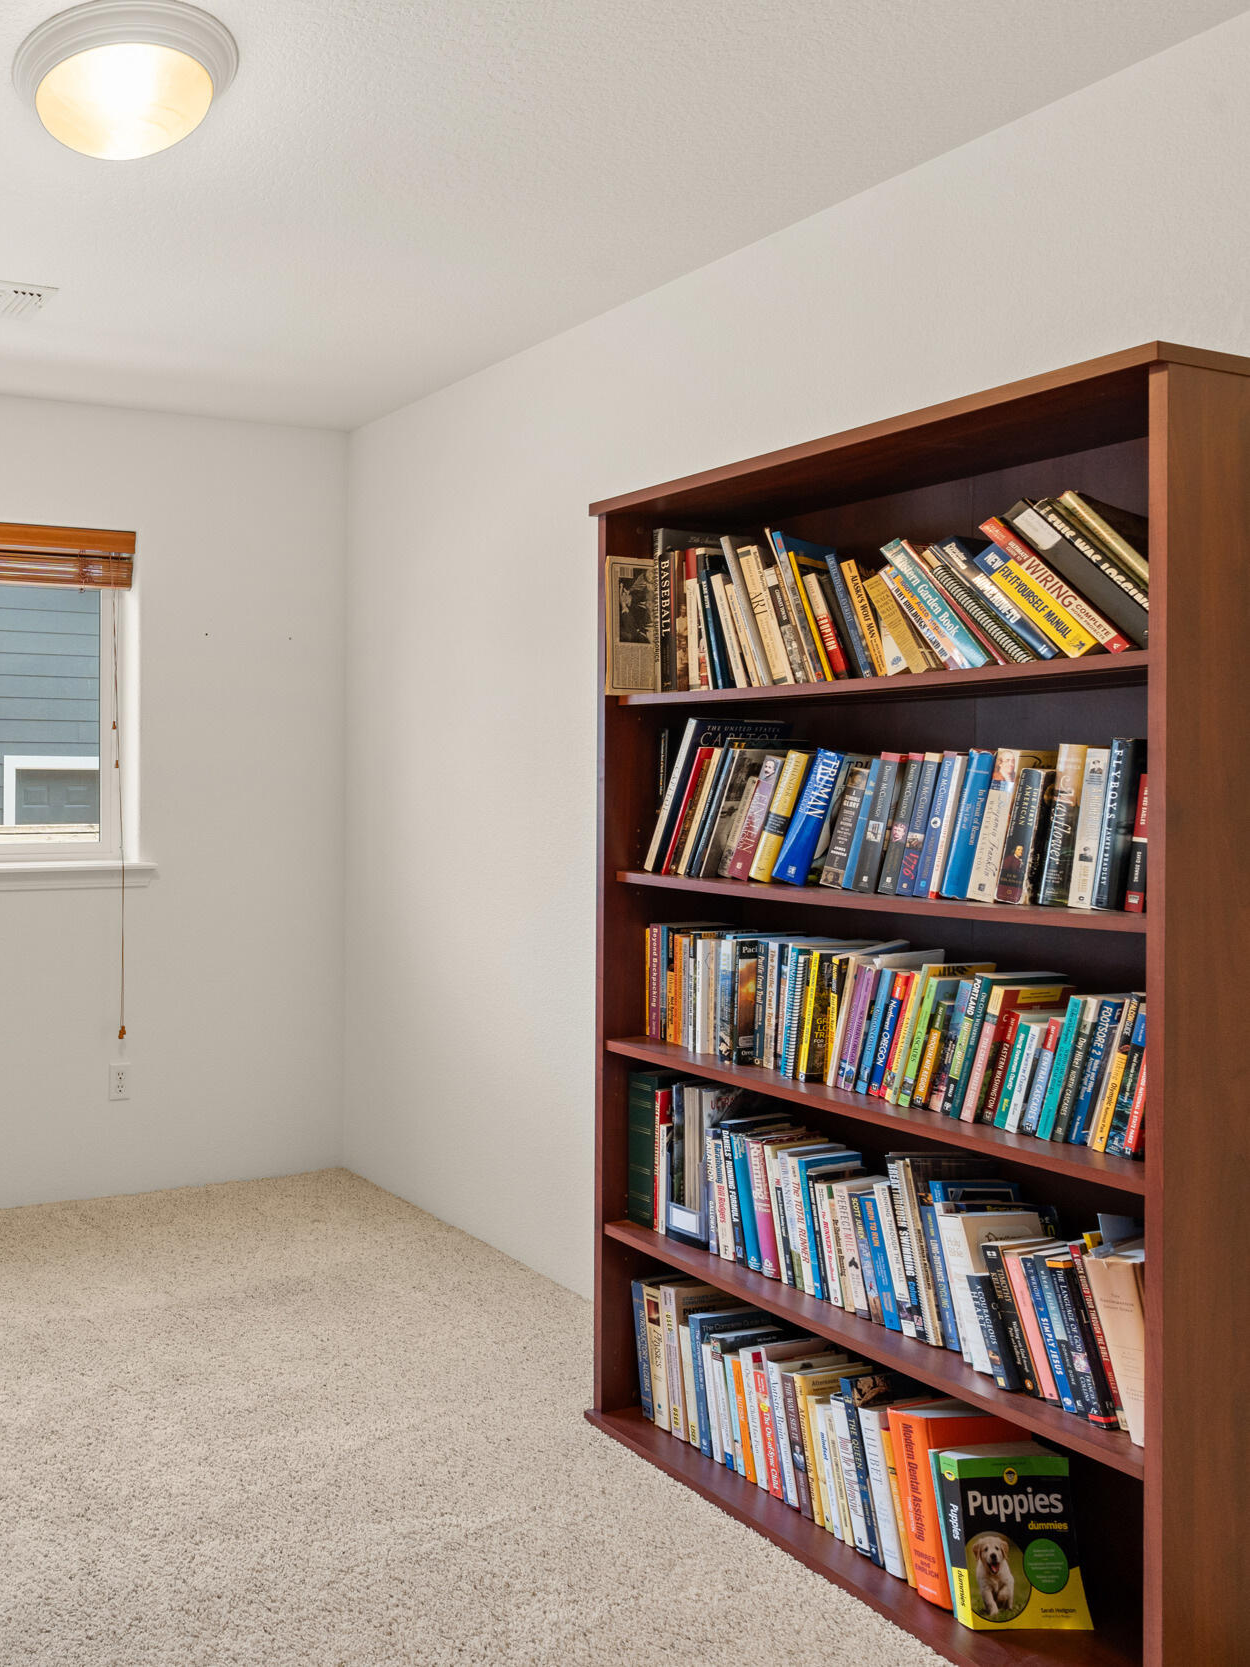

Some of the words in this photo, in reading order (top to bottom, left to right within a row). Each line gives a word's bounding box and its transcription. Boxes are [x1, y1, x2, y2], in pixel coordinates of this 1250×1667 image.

[984, 551, 1004, 570] NEW
[1009, 542, 1028, 559] ULTIMATE
[661, 561, 670, 635] BASEBALL
[1026, 560, 1076, 607] WIRING
[750, 591, 768, 616] ART
[851, 576, 864, 602] ALASKA'S
[859, 603, 871, 622] WOLF
[865, 622, 876, 638] MAN
[916, 583, 943, 615] Garden
[939, 612, 958, 636] Book
[1000, 566, 1047, 611] FIX-IT-YOURSELF
[1043, 608, 1073, 638] MANUAL
[818, 613, 836, 650] ERUPTION
[892, 587, 906, 601] WHY
[904, 600, 926, 628] BUILDINGS
[937, 647, 948, 657] UP
[1076, 604, 1109, 636] COMPLETE
[804, 760, 839, 817] TRUMAN
[1109, 749, 1123, 818] FLYBOYS
[975, 798, 984, 816] Pursuit
[1019, 785, 1032, 825] AMERICAN
[1047, 775, 1077, 862] Mayflower
[744, 792, 768, 854] EINSTEIN
[968, 825, 977, 845] Reason
[903, 853, 918, 879] 1776
[984, 841, 1000, 877] Franklin
[1100, 853, 1108, 884] BRADLEY
[967, 979, 981, 1015] PORTLAND
[885, 1000, 896, 1030] Northwest
[1094, 1007, 1112, 1047] FOOTSORE
[850, 1041, 858, 1063] OREGON
[877, 1032, 889, 1065] OREGON
[911, 1031, 922, 1061] CASCADES
[998, 1044, 1009, 1069] EASTERN
[1077, 1038, 1086, 1049] Day
[1038, 1052, 1050, 1082] CENTRAL
[1073, 1051, 1082, 1067] Hike!
[919, 1070, 928, 1092] REGION
[988, 1071, 1002, 1108] WASHINGTON
[1066, 1070, 1076, 1087] NORTH
[1028, 1084, 1042, 1118] CASCADES
[1061, 1089, 1071, 1115] CASCADES
[1134, 1086, 1144, 1109] NATIONAL
[722, 1130, 731, 1158] DANIELS'
[1127, 1129, 1135, 1143] PARKS
[713, 1143, 723, 1183] Marathoning
[726, 1161, 734, 1188] RUNNING
[750, 1144, 765, 1199] Running
[791, 1181, 800, 1197] The
[730, 1191, 738, 1221] FORMULA
[795, 1200, 804, 1224] TOTAL
[852, 1198, 860, 1216] SCOTT
[866, 1202, 874, 1220] BORN
[881, 1188, 890, 1217] RUNNING
[888, 1220, 896, 1250] THROUGH
[837, 1195, 850, 1230] PERFECT
[844, 1233, 854, 1252] MILE
[869, 1222, 876, 1230] TO
[887, 1163, 903, 1227] BREAKTHROUGH
[900, 1231, 913, 1275] SWIMMING
[908, 1282, 917, 1305] Colwin
[799, 1228, 809, 1262] RUNNER
[931, 1240, 944, 1281] LONG-DISTANCE
[939, 1284, 949, 1308] CYCLING
[1074, 1258, 1084, 1274] QUICK
[991, 1272, 1003, 1298] KELLER
[997, 1269, 1011, 1302] TIMOTHY
[1079, 1275, 1088, 1289] GUIDED
[971, 1290, 987, 1329] HEART
[1056, 1270, 1064, 1282] THE
[1060, 1286, 1074, 1321] LANGUAGE
[1070, 1323, 1078, 1333] OF
[1074, 1335, 1082, 1351] GOD
[1084, 1291, 1094, 1308] TOUR
[974, 1292, 996, 1344] COURAGEOUS
[1090, 1310, 1101, 1333] THROUGH
[650, 1329, 661, 1367] Physics
[1041, 1318, 1055, 1346] SIMPLY
[1050, 1350, 1063, 1374] JESUS
[1095, 1335, 1104, 1344] THE
[1098, 1345, 1109, 1362] BIBLE
[1061, 1344, 1071, 1367] DOMINIC
[1067, 1369, 1076, 1385] DONE
[1080, 1377, 1090, 1401] COLLINS
[1107, 1371, 1117, 1393] MILLER
[847, 1419, 857, 1435] THE
[901, 1423, 916, 1459] Modern
[765, 1427, 775, 1466] Out-of-Sync
[797, 1408, 807, 1452] Afternoons
[806, 1477, 815, 1502] Puppy
[839, 1437, 850, 1453] Don't
[842, 1455, 854, 1465] Be
[851, 1439, 862, 1468] QUEEN
[862, 1428, 882, 1484] LILIBET
[845, 1468, 856, 1477] So
[906, 1461, 921, 1494] Dental
[910, 1495, 928, 1541] Assisting
[967, 1487, 1064, 1522] Puppies
[949, 1503, 961, 1540] Puppies
[1028, 1520, 1068, 1530] dummies
[914, 1549, 936, 1565] TORRES
[915, 1564, 939, 1580] EHRLICH
[957, 1570, 966, 1606] dummies
